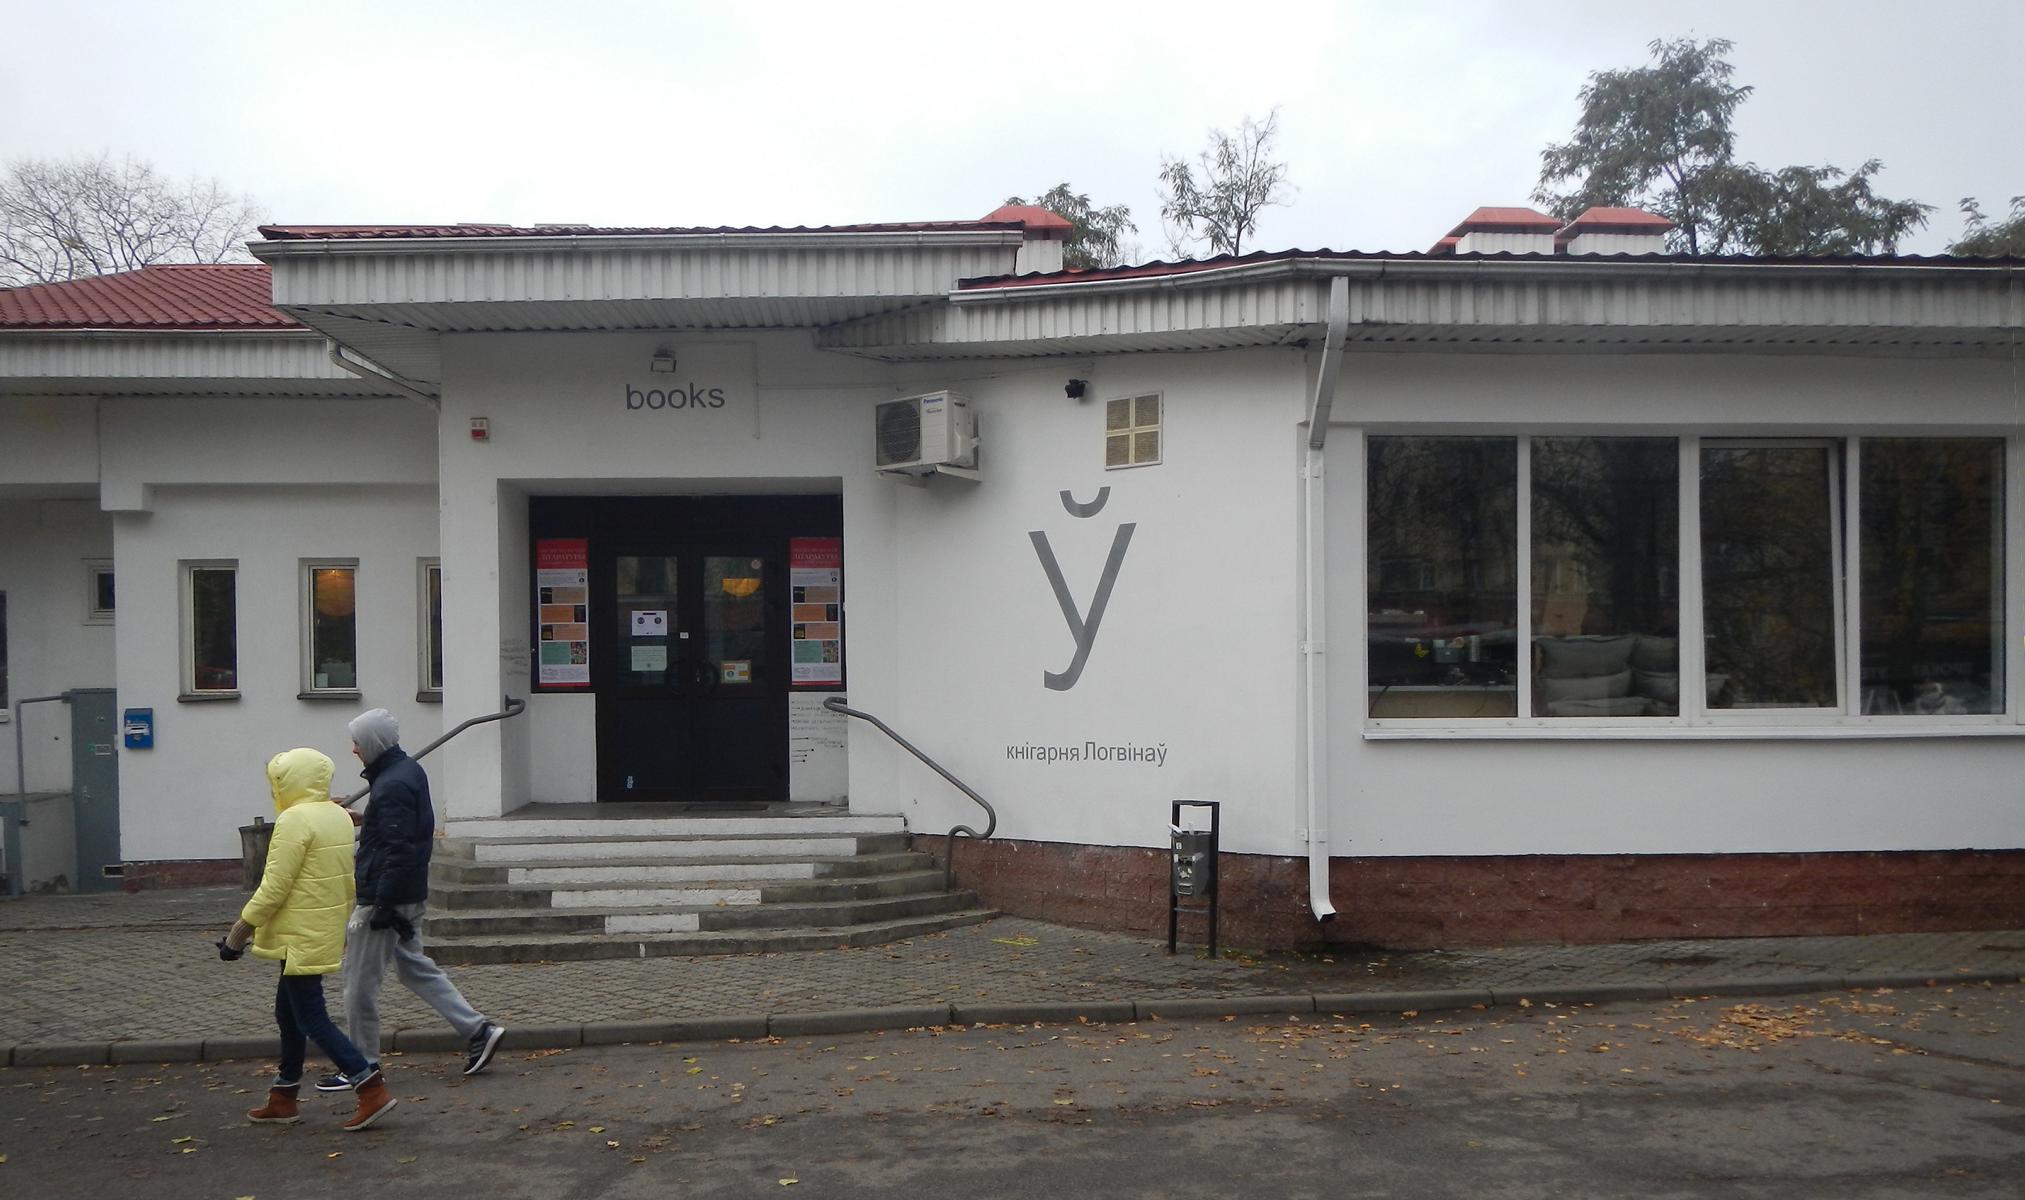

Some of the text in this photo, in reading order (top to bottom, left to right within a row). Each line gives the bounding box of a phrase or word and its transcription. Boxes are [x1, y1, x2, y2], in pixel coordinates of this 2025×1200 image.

[626, 382, 725, 410] books
[1006, 742, 1168, 767] кнігарня Логвінаў
